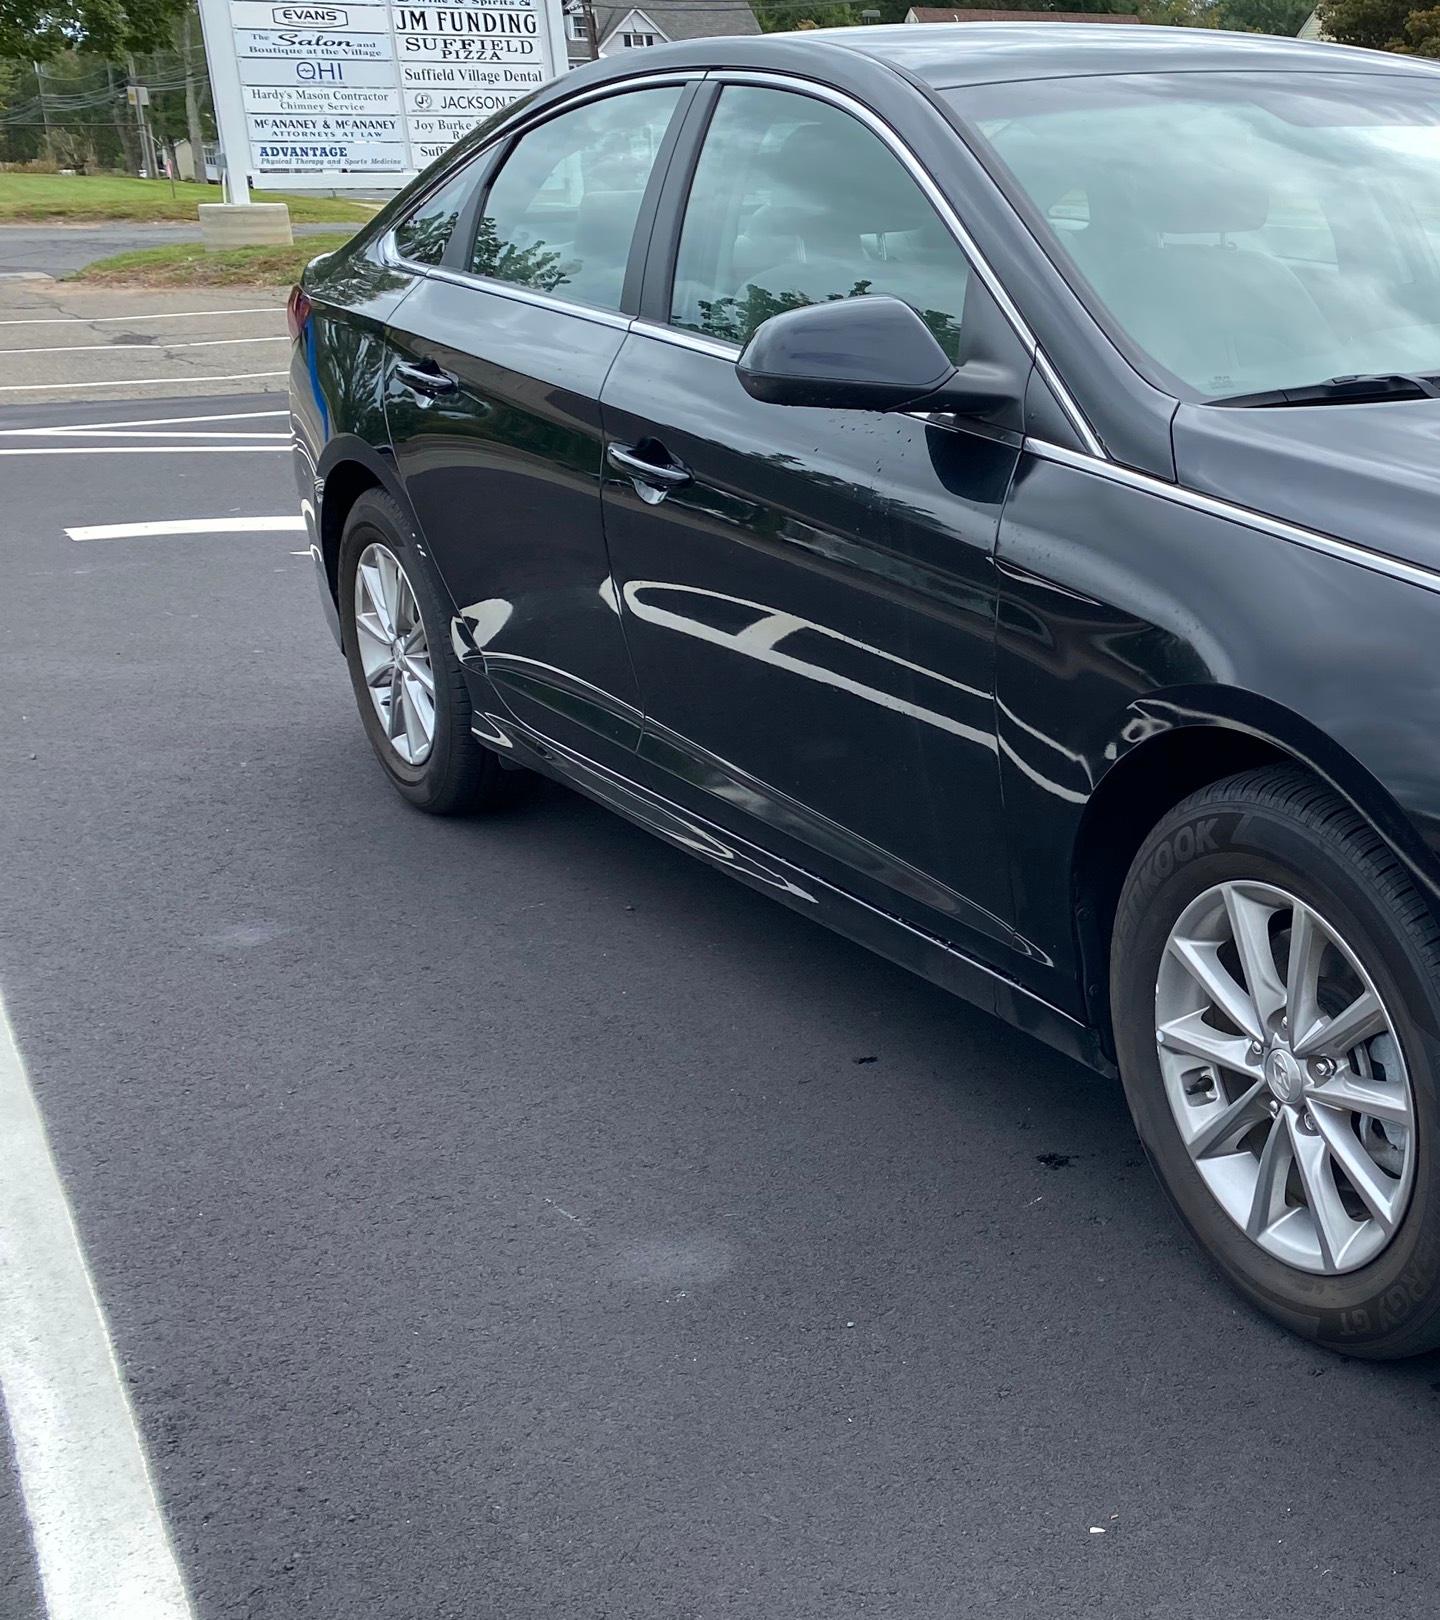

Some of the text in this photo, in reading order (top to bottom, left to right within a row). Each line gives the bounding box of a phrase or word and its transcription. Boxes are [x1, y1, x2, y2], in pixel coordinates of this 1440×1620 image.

[282, 9, 337, 20] EVANS
[396, 10, 537, 34] JM FUNDING
[272, 33, 356, 47] Salon
[405, 36, 534, 55] SUFFIELD
[248, 46, 301, 56] Boutique
[342, 48, 382, 57] Village
[442, 50, 502, 61] PIZZA
[296, 61, 343, 80] QHI
[404, 68, 543, 84] Suffield Village Dental
[251, 89, 389, 102] Hardy's Mason Contractor
[280, 102, 365, 112] Chimney Service
[440, 96, 506, 109] JACKSON
[322, 119, 331, 129] &
[414, 120, 434, 133] Joy
[438, 120, 472, 130] Burke
[259, 146, 347, 157] ADVANTAGE
[261, 158, 292, 166] Physical
[295, 158, 324, 167] Therapy
[371, 158, 402, 166] Medicine
